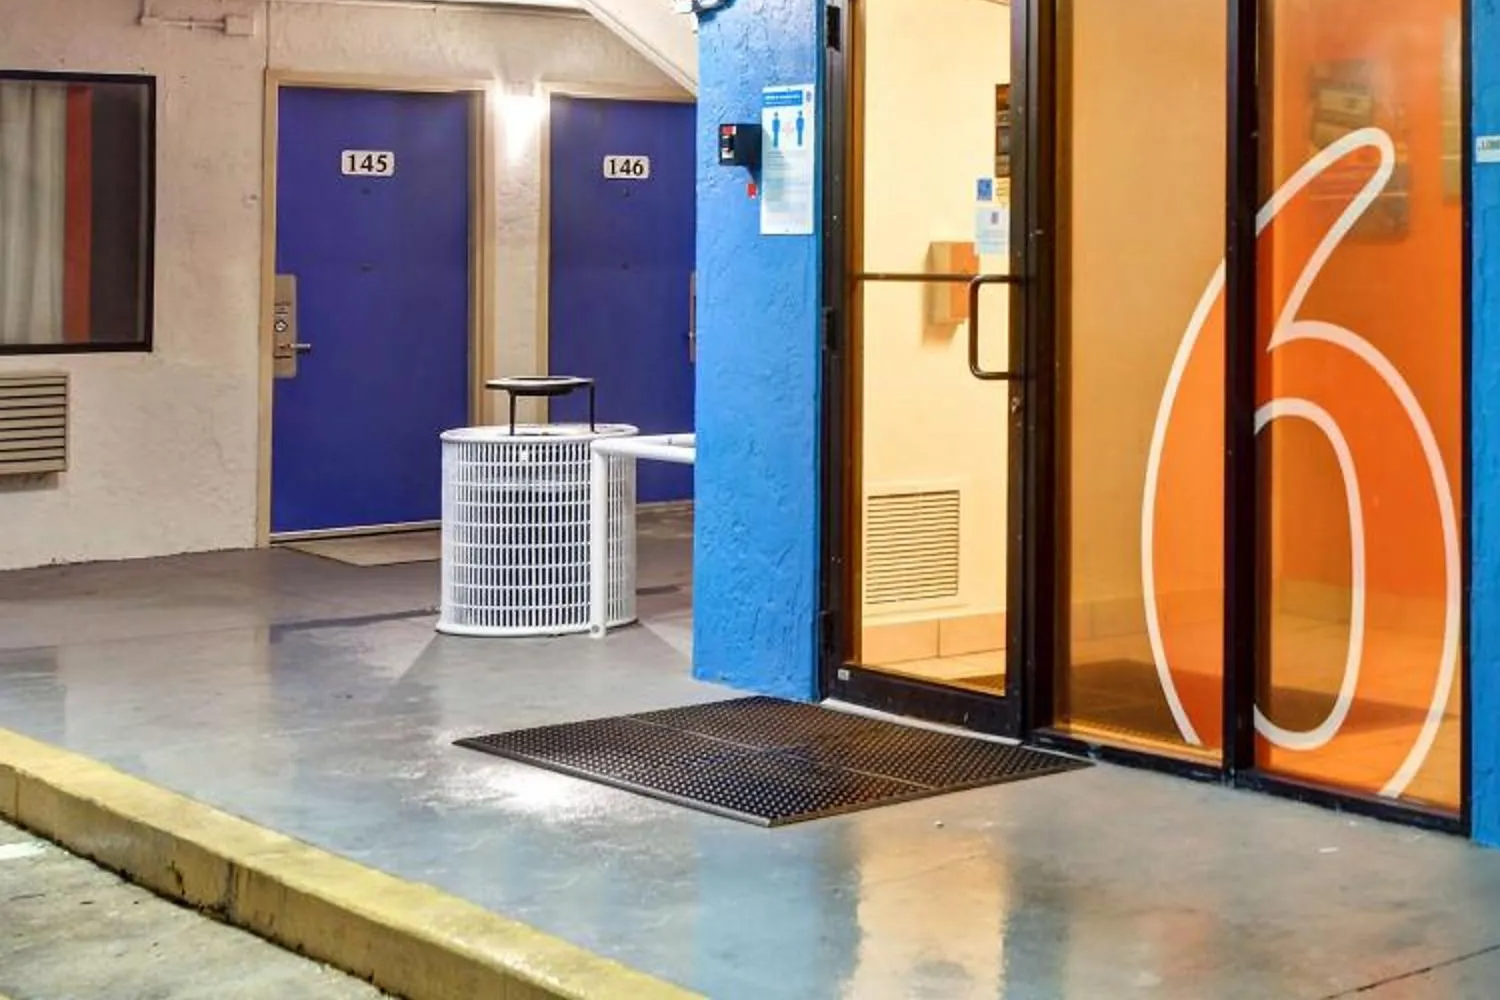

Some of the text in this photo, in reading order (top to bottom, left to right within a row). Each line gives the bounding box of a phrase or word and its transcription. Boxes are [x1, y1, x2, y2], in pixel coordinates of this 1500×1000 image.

[347, 154, 387, 172] 145
[609, 159, 644, 176] 146
[1141, 127, 1461, 797] 6
